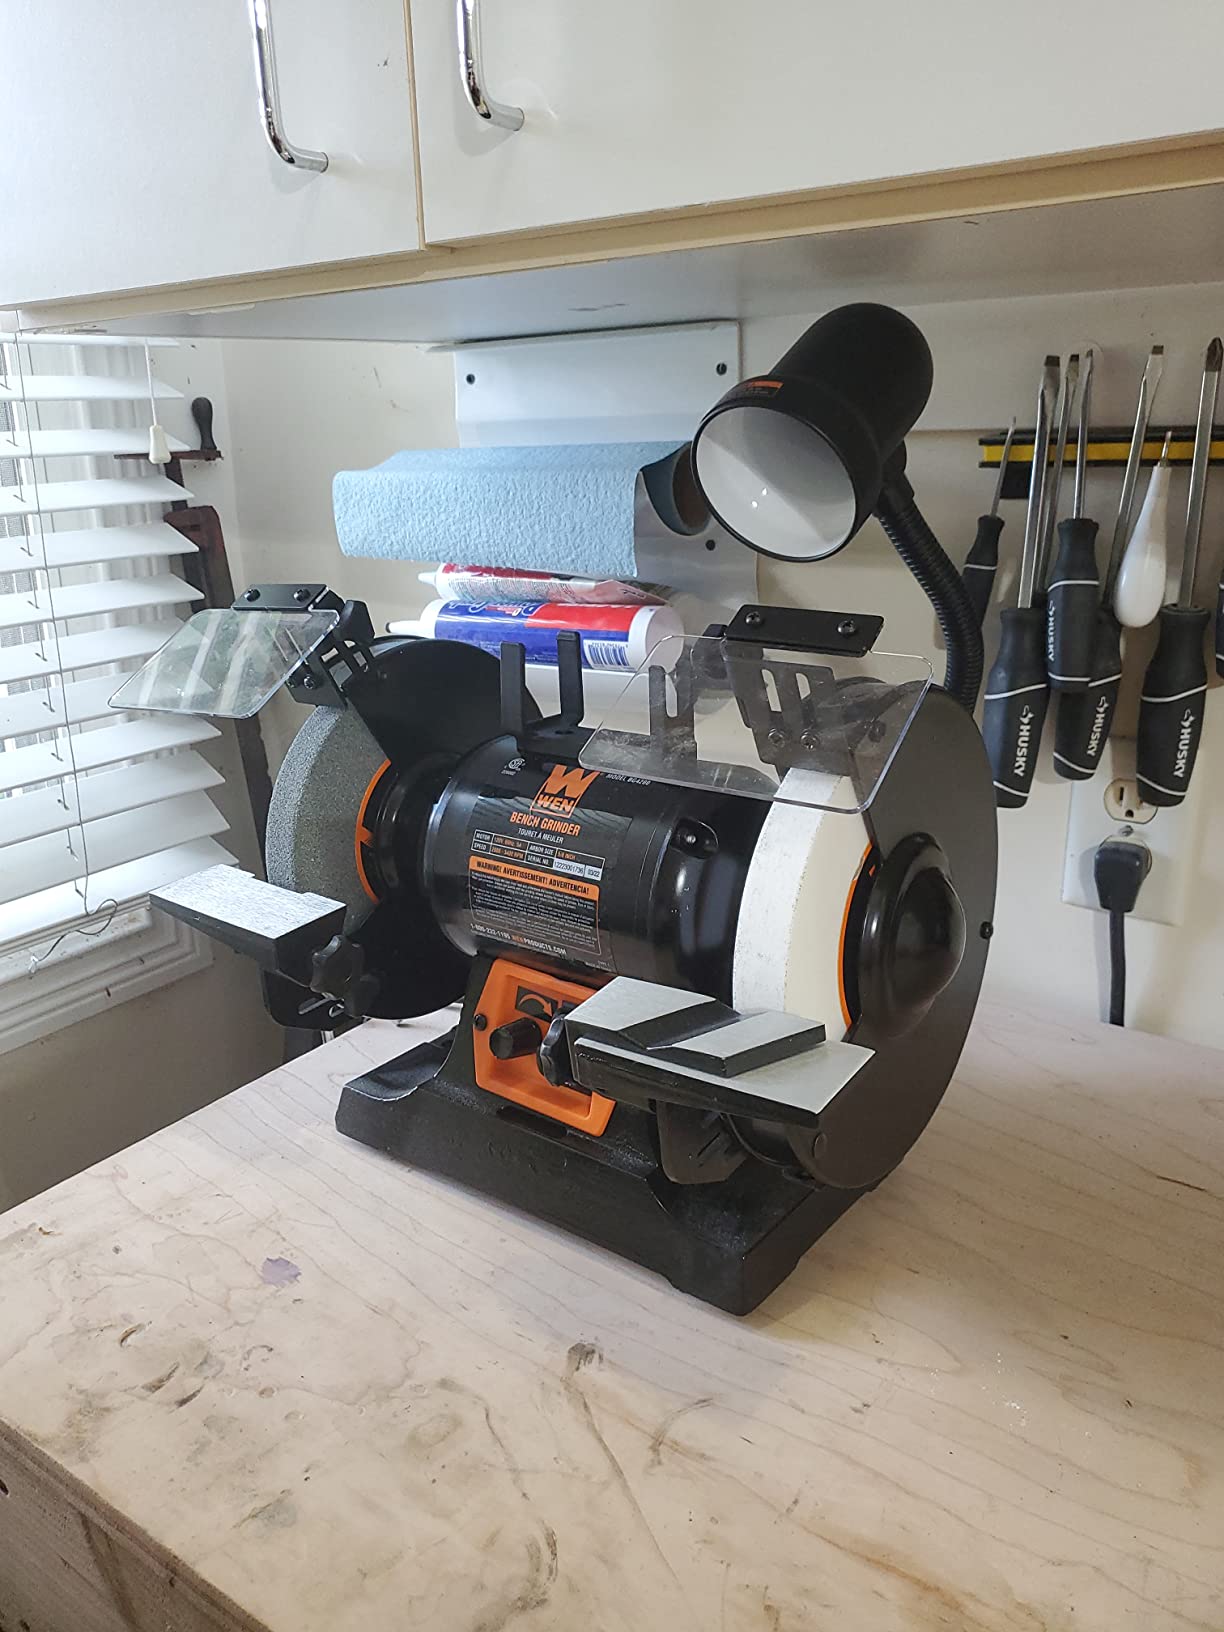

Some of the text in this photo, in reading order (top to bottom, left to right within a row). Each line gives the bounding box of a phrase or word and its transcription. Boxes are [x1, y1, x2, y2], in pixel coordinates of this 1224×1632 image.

[1047, 616, 1055, 662] HUSKY
[1014, 723, 1031, 777] HUSKY
[1087, 716, 1105, 757] HUSKY
[1173, 727, 1192, 778] HUSKY
[605, 773, 627, 782] MODEL
[537, 794, 575, 813] WEN
[510, 811, 581, 837] BENCH GRINDER
[518, 828, 538, 838] TOURET
[543, 833, 564, 845] MEULER
[473, 841, 487, 851] SPEED
[476, 860, 502, 873] WARNING!
[502, 866, 549, 884] AVERTISSEMENT!
[549, 878, 590, 895] ADVERTENCIA!
